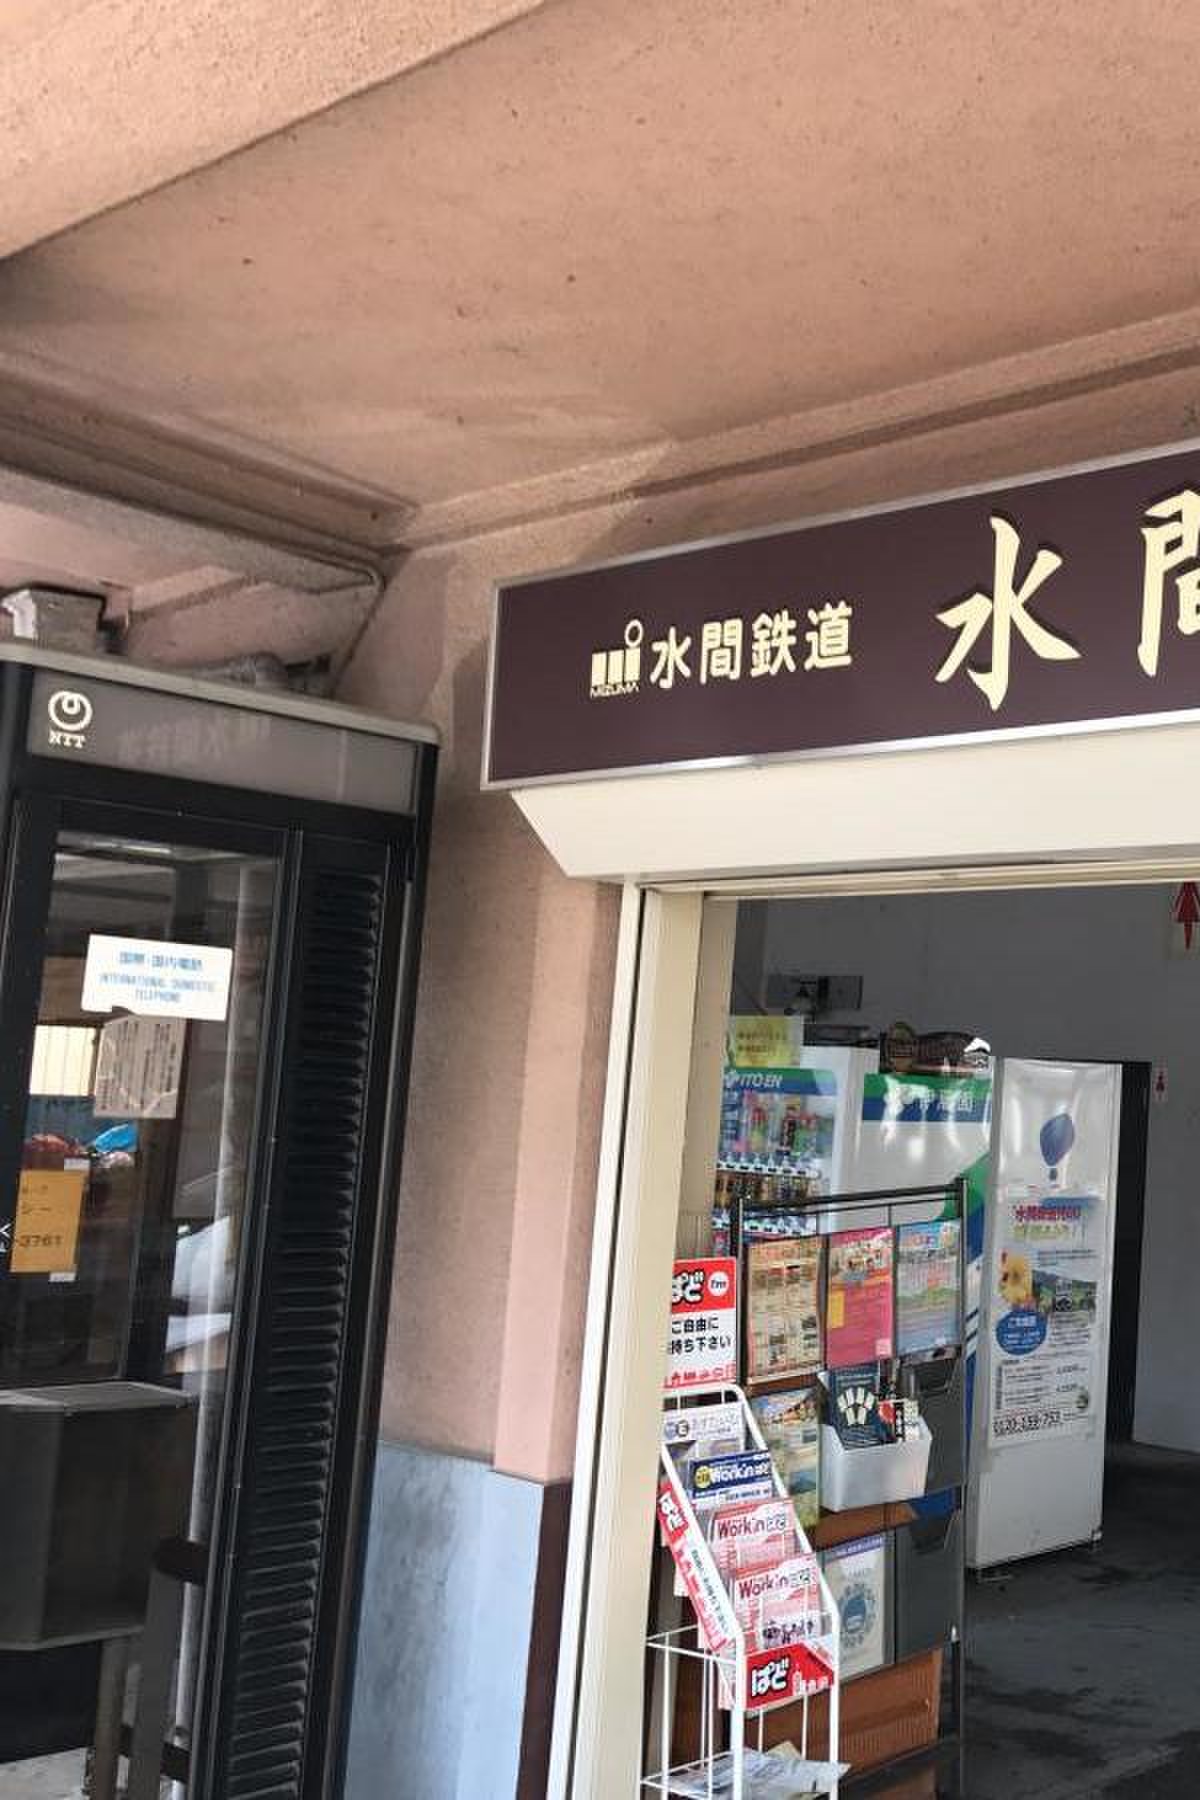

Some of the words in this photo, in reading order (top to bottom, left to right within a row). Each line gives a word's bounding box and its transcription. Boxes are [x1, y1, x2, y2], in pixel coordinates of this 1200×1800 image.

[650, 601, 852, 689] 水間鉄道
[48, 731, 87, 748] NTT
[750, 1656, 790, 1698] ぱど
